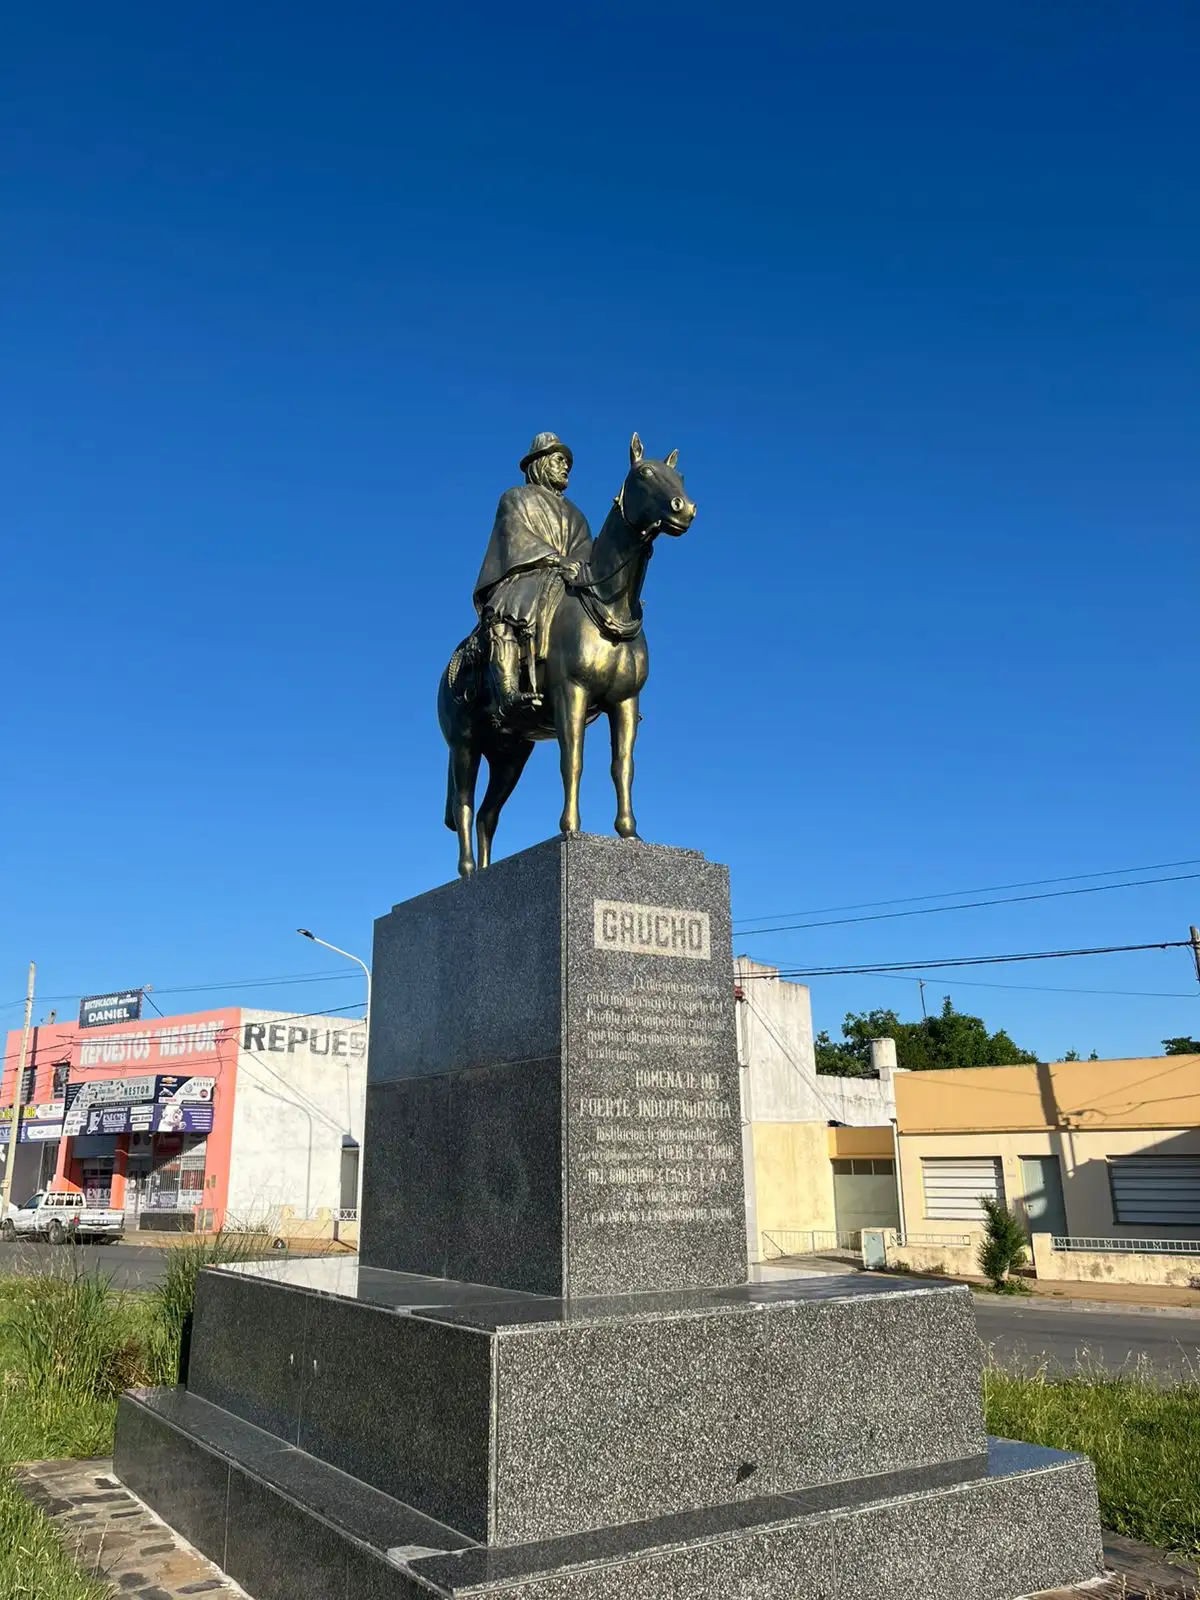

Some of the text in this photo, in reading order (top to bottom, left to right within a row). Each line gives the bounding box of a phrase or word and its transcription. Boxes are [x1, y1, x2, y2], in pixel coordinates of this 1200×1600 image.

[602, 908, 702, 951] GAUCHO
[88, 1007, 131, 1023] DANIEL
[80, 1031, 151, 1065] REPUESTOS
[636, 1069, 720, 1090] HOMENAJE DEL
[124, 1085, 150, 1096] NESTOR
[579, 1097, 732, 1119] FUERTE INDEPENDENCIA
